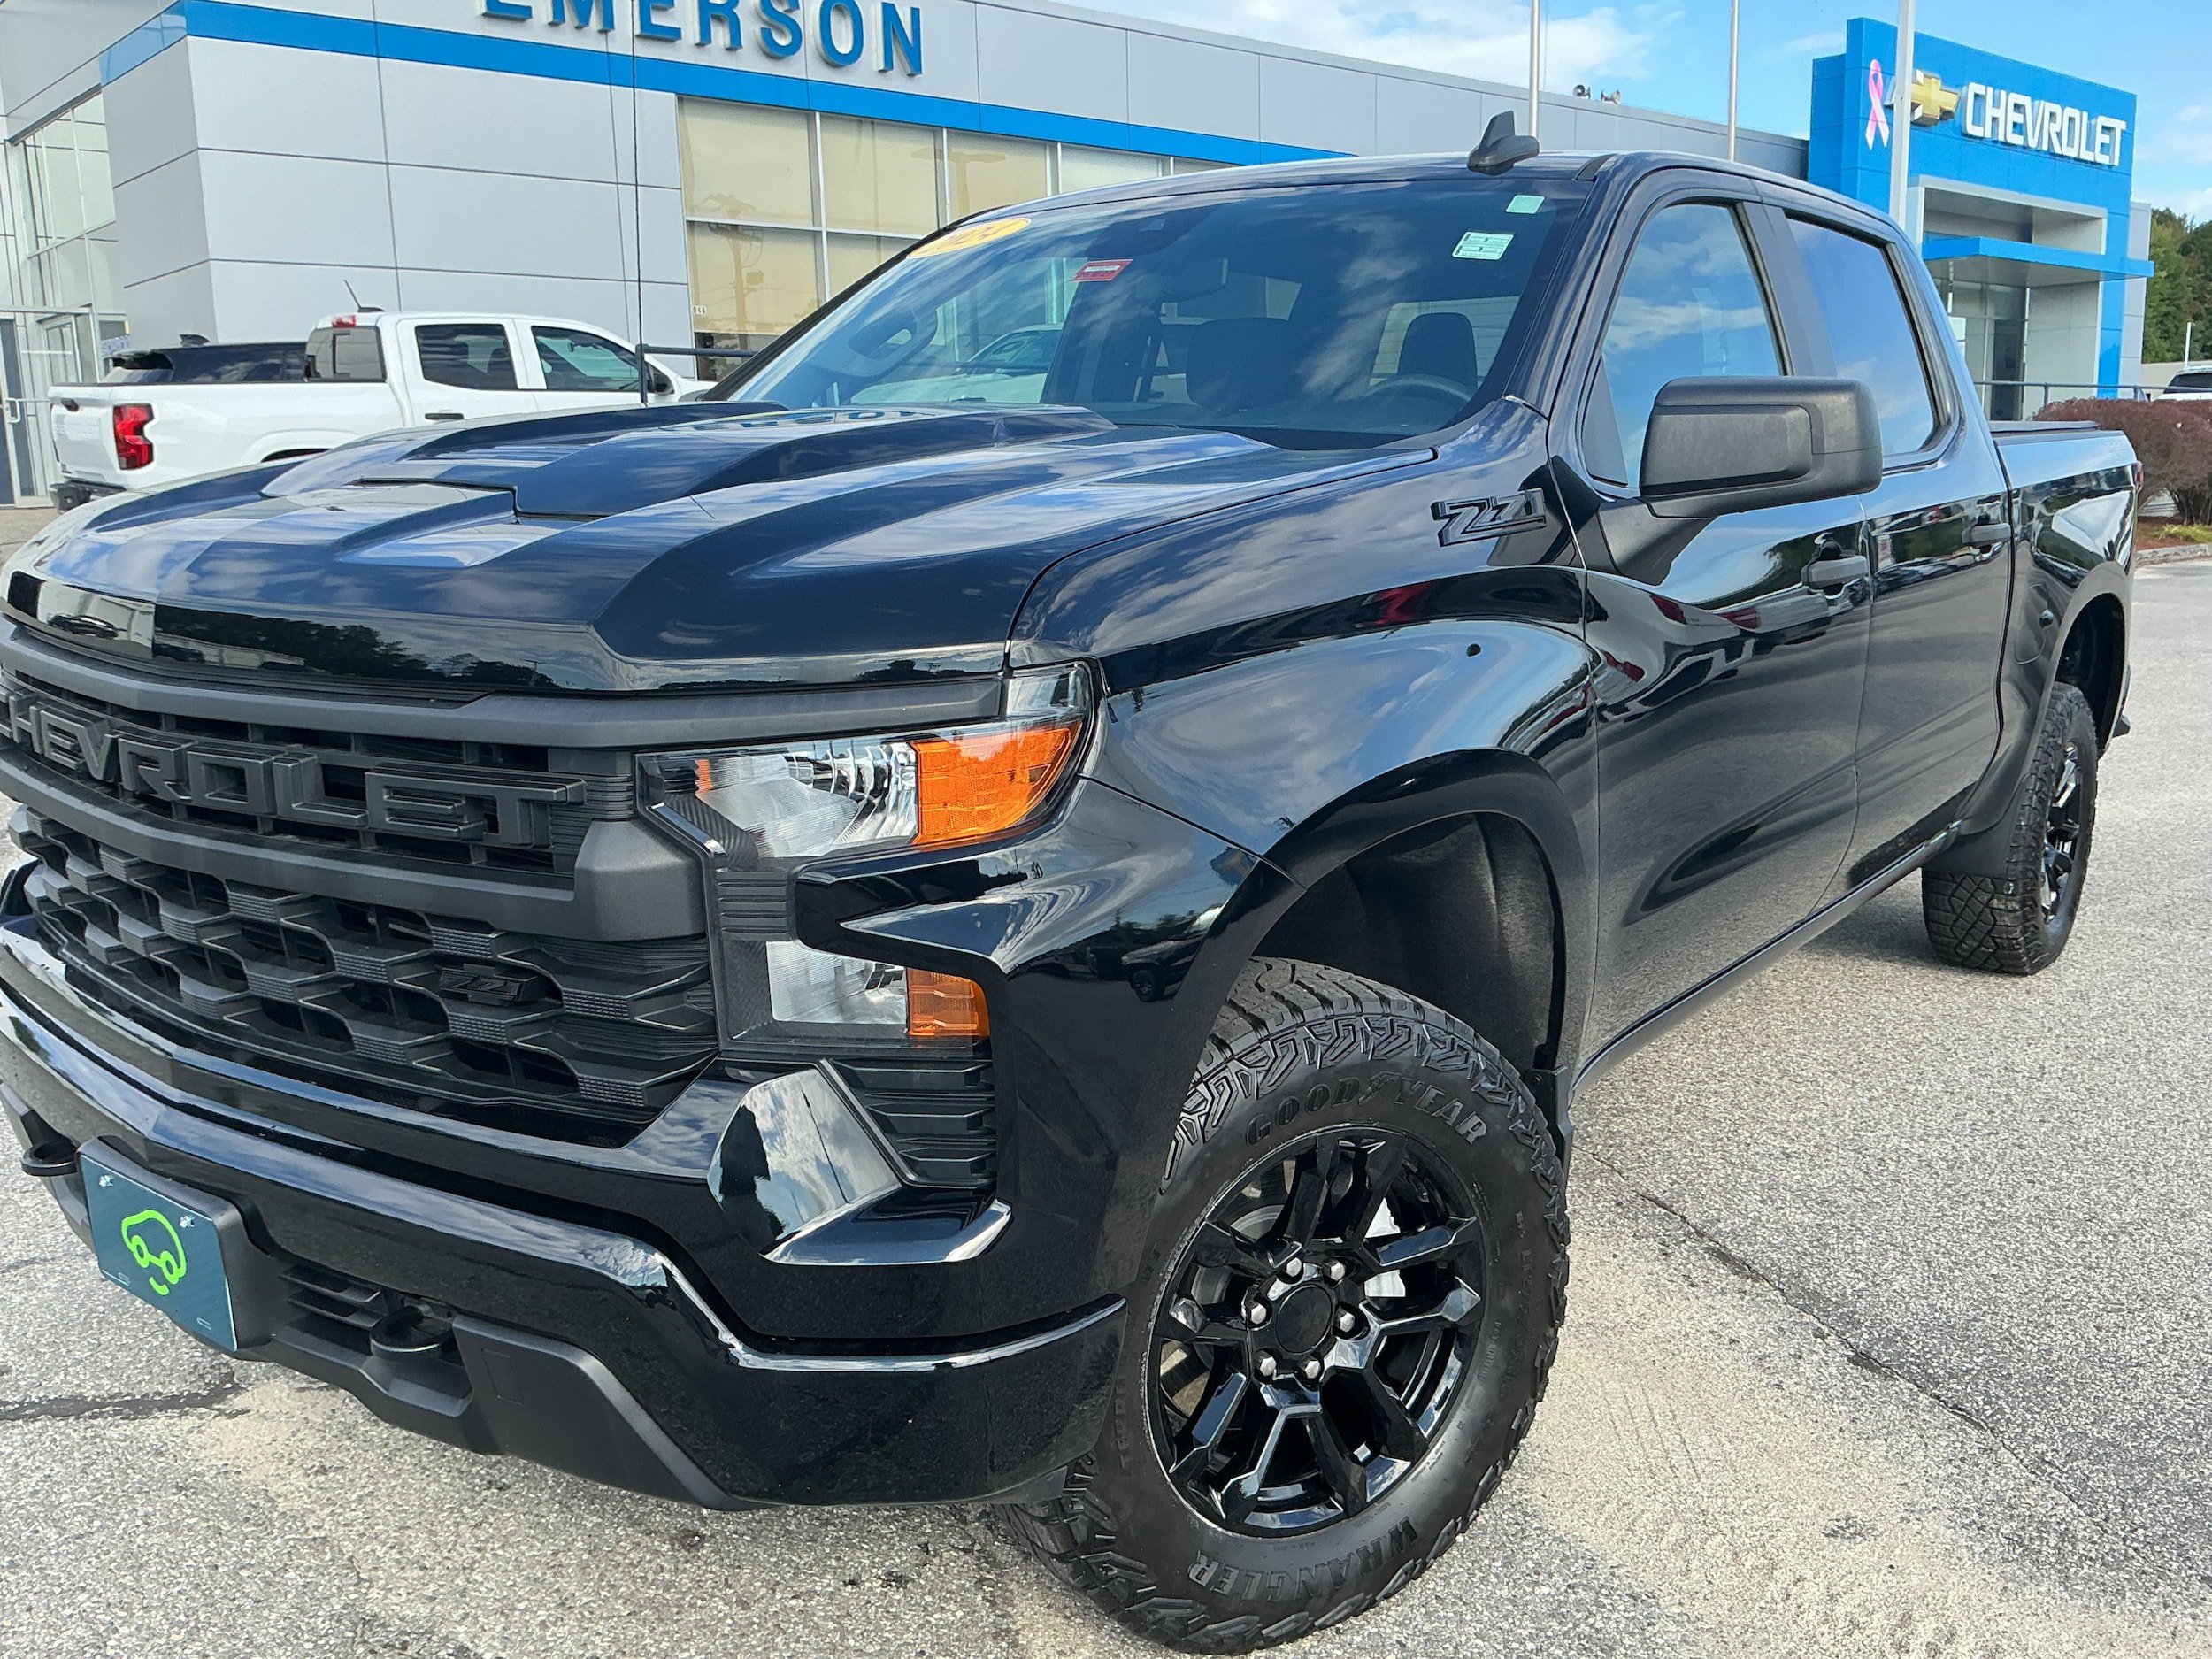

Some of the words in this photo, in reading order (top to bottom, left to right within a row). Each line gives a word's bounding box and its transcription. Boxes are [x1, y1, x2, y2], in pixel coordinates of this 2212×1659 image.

[482, 0, 923, 76] ERSON
[1964, 81, 2126, 166] CHEVROLET
[1431, 488, 1547, 547] Z71
[438, 968, 524, 1001] Z71
[1187, 1516, 1419, 1602] WRANGLER
